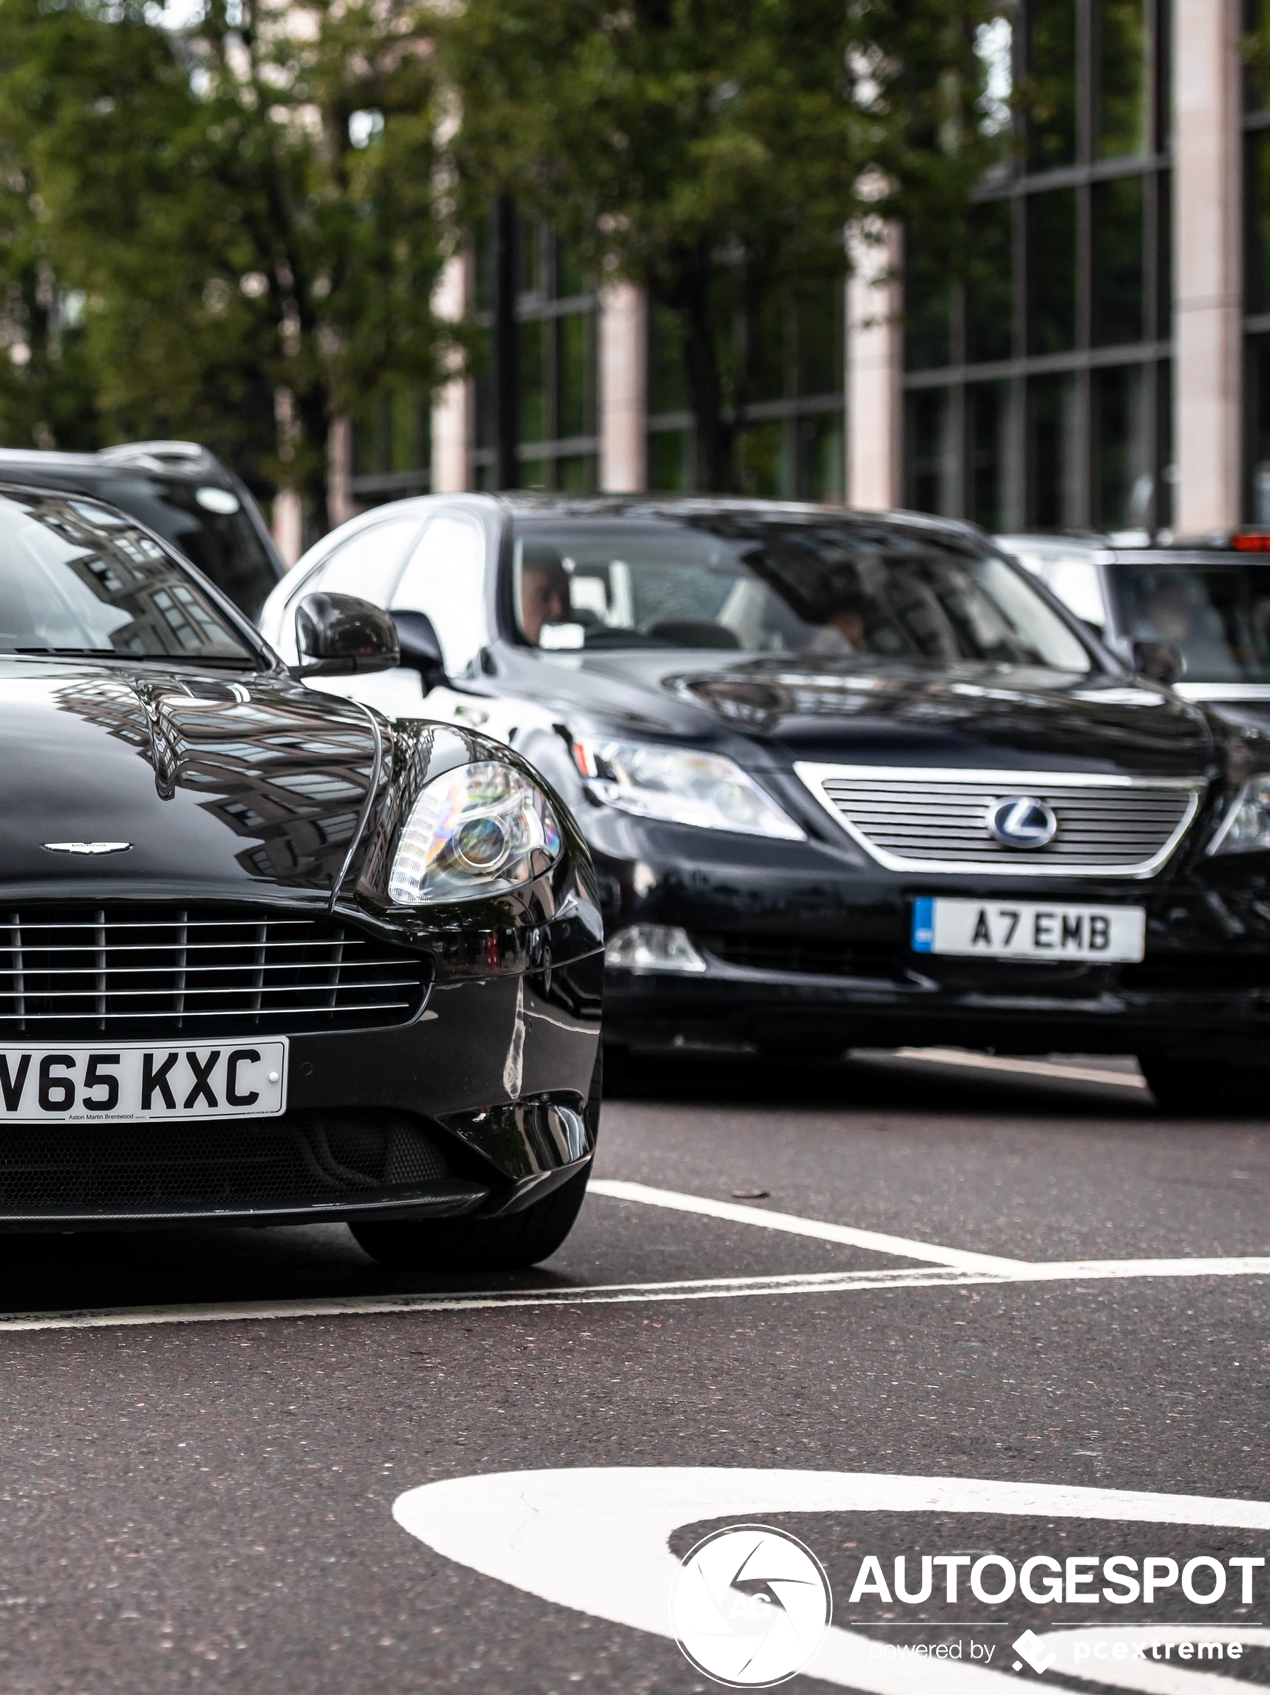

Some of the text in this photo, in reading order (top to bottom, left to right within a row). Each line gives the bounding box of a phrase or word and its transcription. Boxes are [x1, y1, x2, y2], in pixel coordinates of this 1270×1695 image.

[970, 907, 1111, 952] A7 EMB
[140, 1048, 262, 1111] KXC
